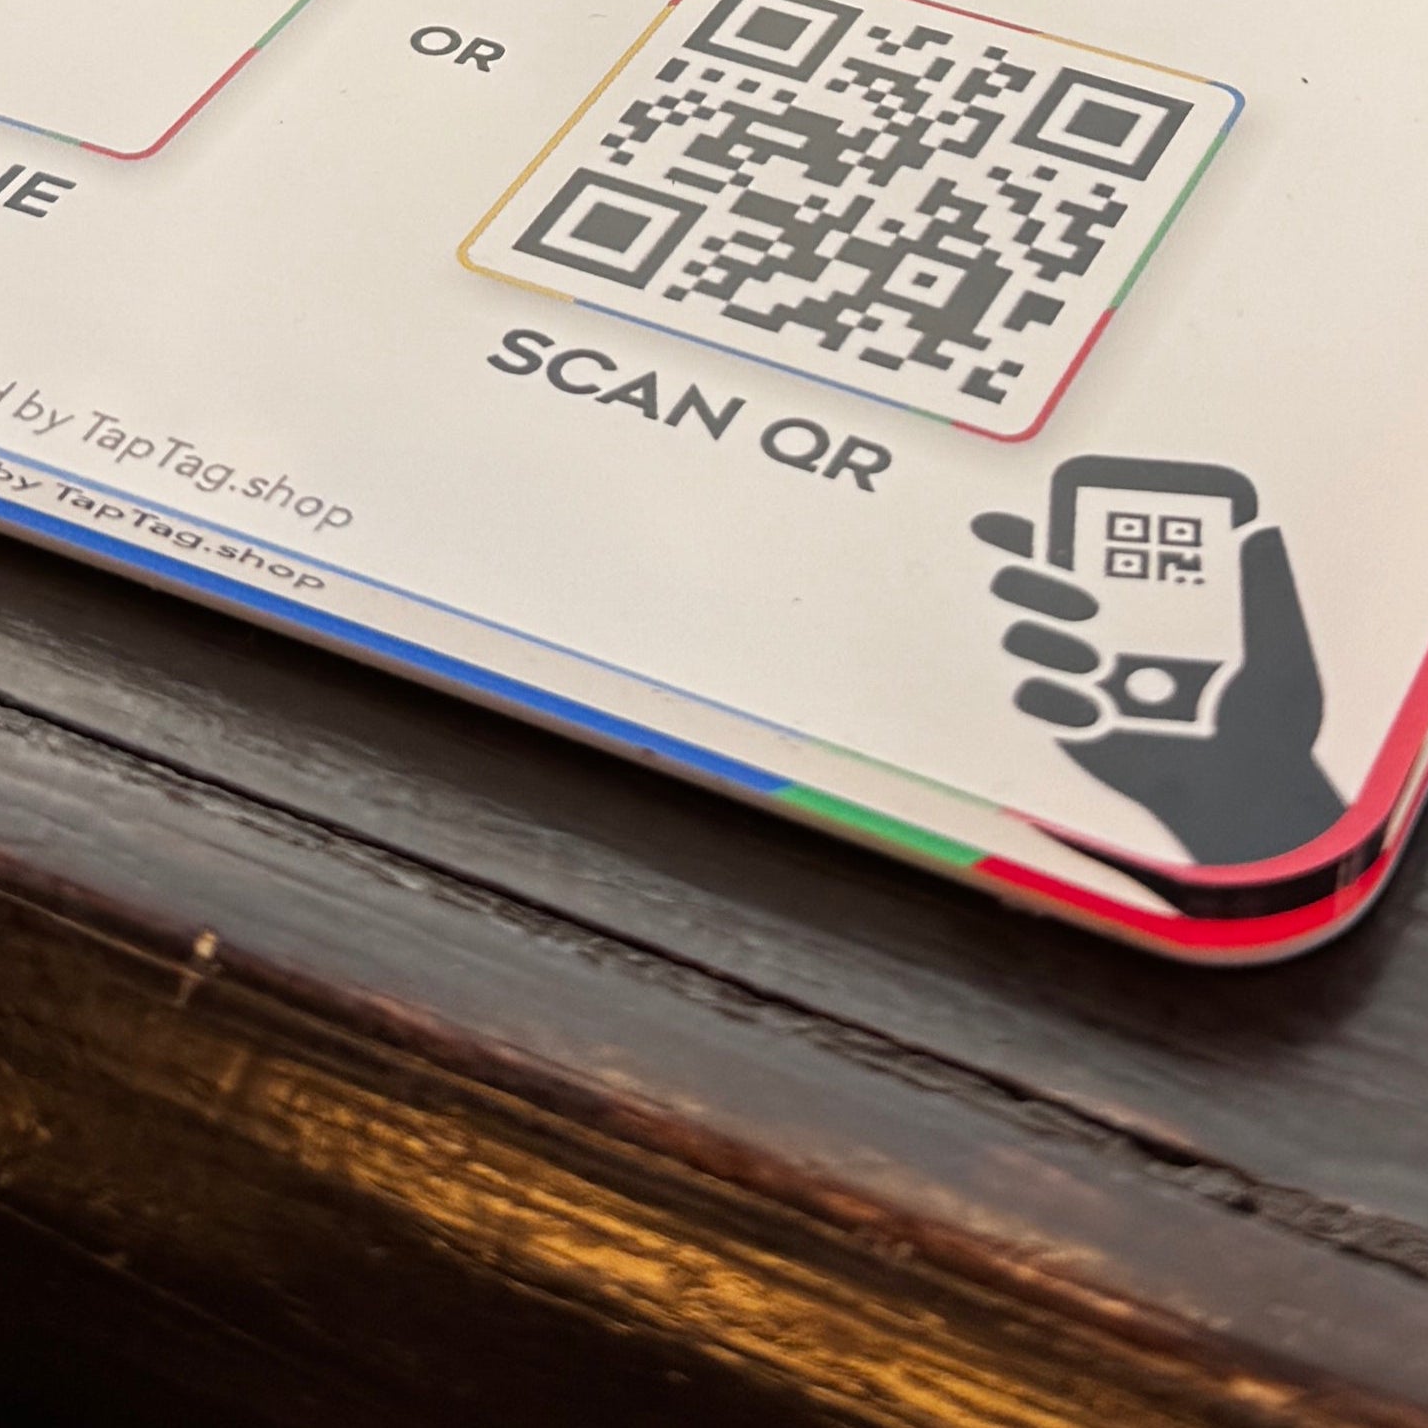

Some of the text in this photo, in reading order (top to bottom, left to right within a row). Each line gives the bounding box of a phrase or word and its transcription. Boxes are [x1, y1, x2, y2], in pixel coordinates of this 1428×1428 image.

[409, 25, 506, 73] OR
[13, 389, 74, 435] by
[80, 410, 355, 533] TapTag.shop
[487, 328, 893, 493] SCAN QR
[55, 482, 327, 592] TapTag.shop
